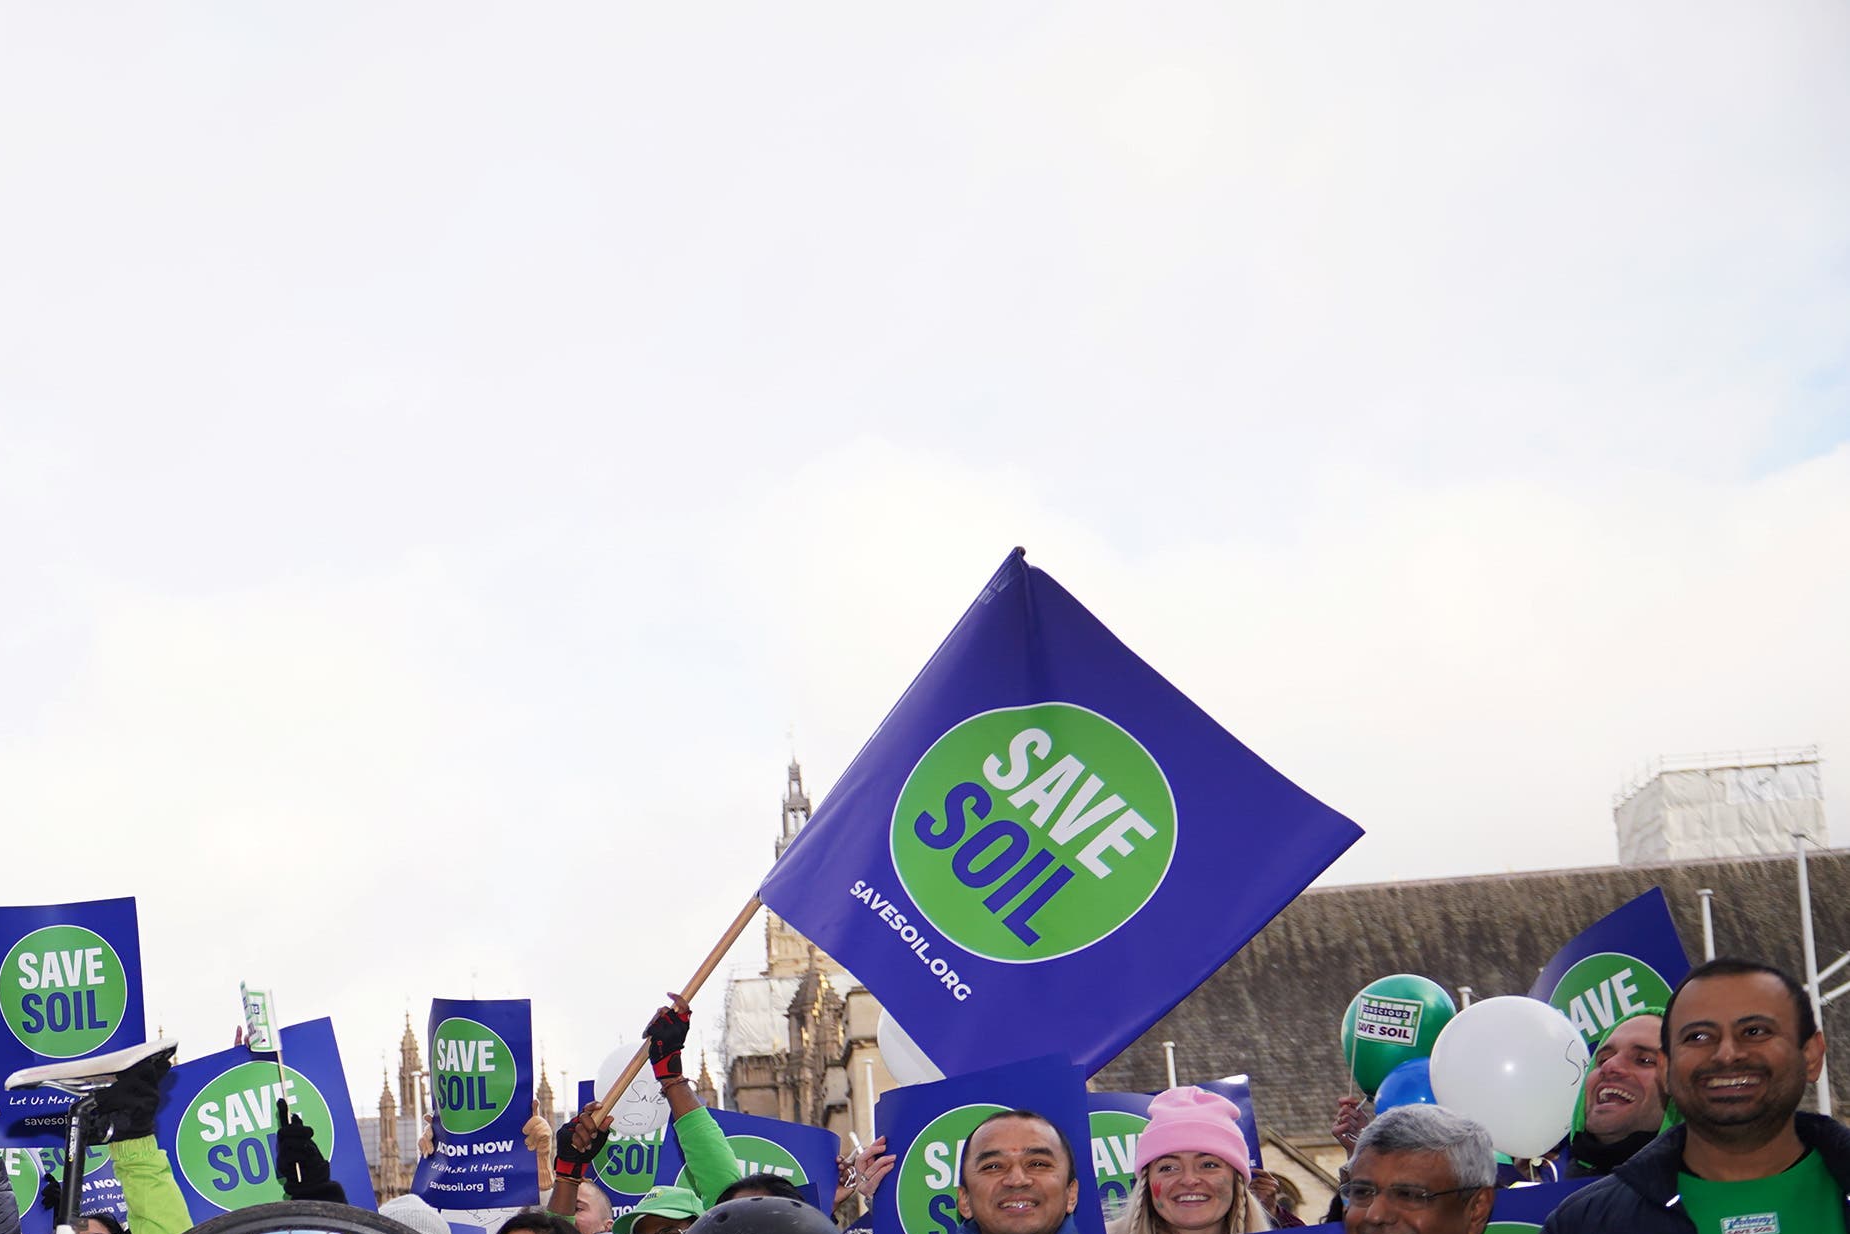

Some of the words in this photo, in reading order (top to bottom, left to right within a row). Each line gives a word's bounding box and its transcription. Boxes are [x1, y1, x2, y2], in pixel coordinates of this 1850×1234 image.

[983, 728, 1157, 879] SAVE
[914, 781, 1075, 946] SOIL
[849, 880, 971, 1002] SAVESOIL.ORG
[18, 947, 106, 990] SAVE
[21, 989, 108, 1034] SOIL
[1568, 966, 1645, 1037] AVE
[1379, 1027, 1410, 1039] SOIL
[437, 1038, 496, 1073] SAVE
[9, 1096, 27, 1106] Let
[31, 1096, 44, 1105] Us
[48, 1095, 76, 1106] Make
[438, 1074, 497, 1111] SOIL
[24, 1115, 68, 1127] savesoi
[208, 1133, 282, 1191] SOI
[473, 1140, 514, 1155] NOW
[607, 1143, 661, 1176] SOI
[470, 1164, 478, 1173] It
[481, 1163, 514, 1174] Happen
[429, 1180, 485, 1194] savesoil.org
